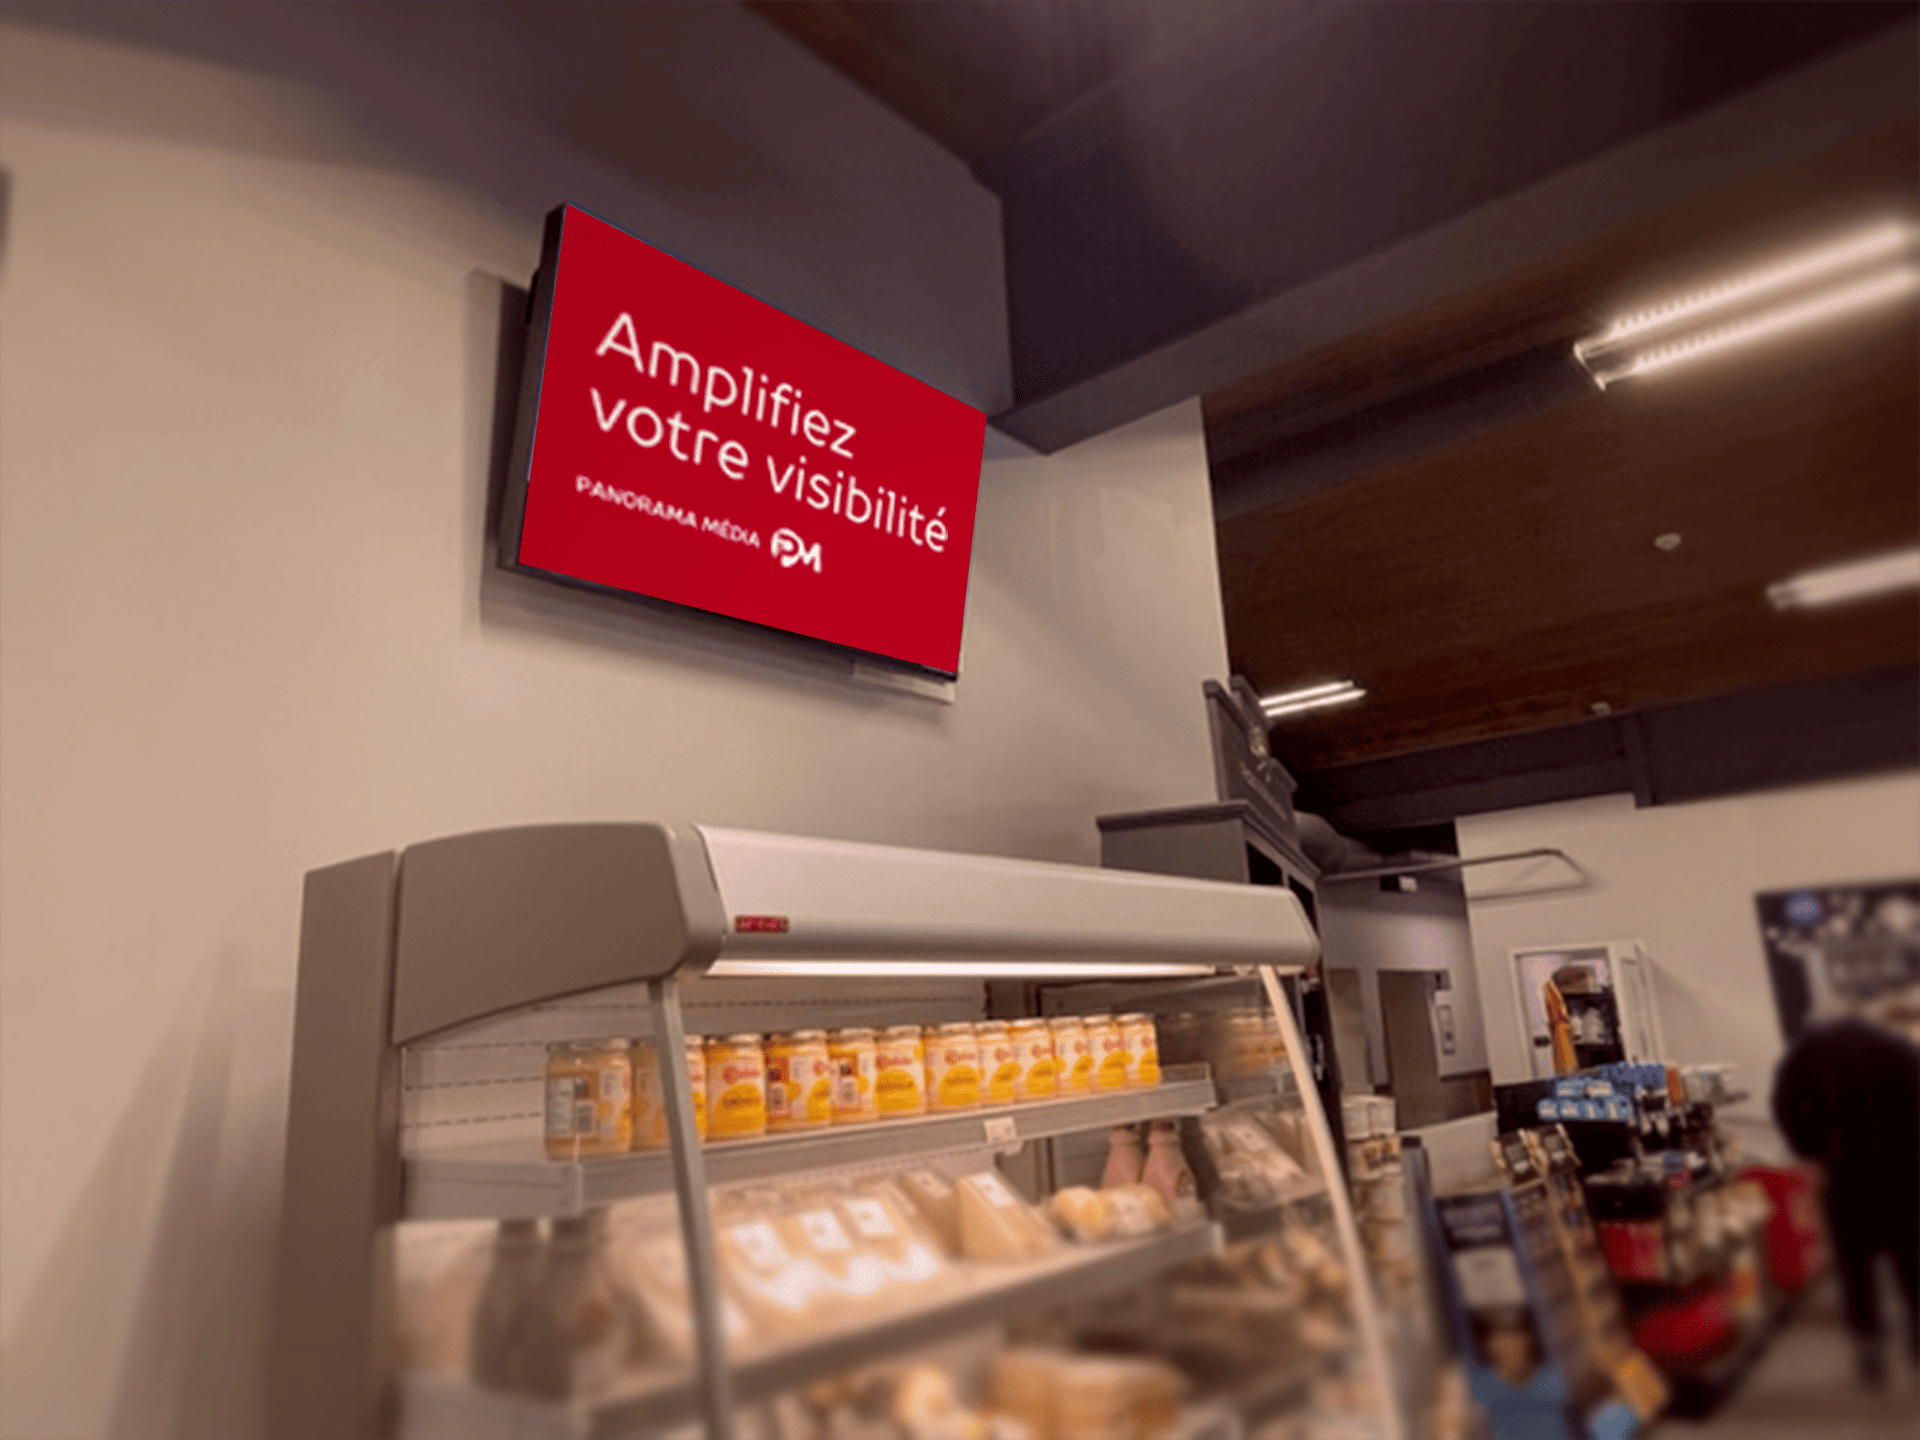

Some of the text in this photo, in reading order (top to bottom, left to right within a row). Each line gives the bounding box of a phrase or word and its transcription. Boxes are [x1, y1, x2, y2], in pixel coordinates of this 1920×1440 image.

[595, 311, 858, 460] Amplifiez
[575, 475, 698, 529] PANORAMA
[701, 516, 761, 549] MÉDIA
[590, 387, 950, 554] votre visibilité
